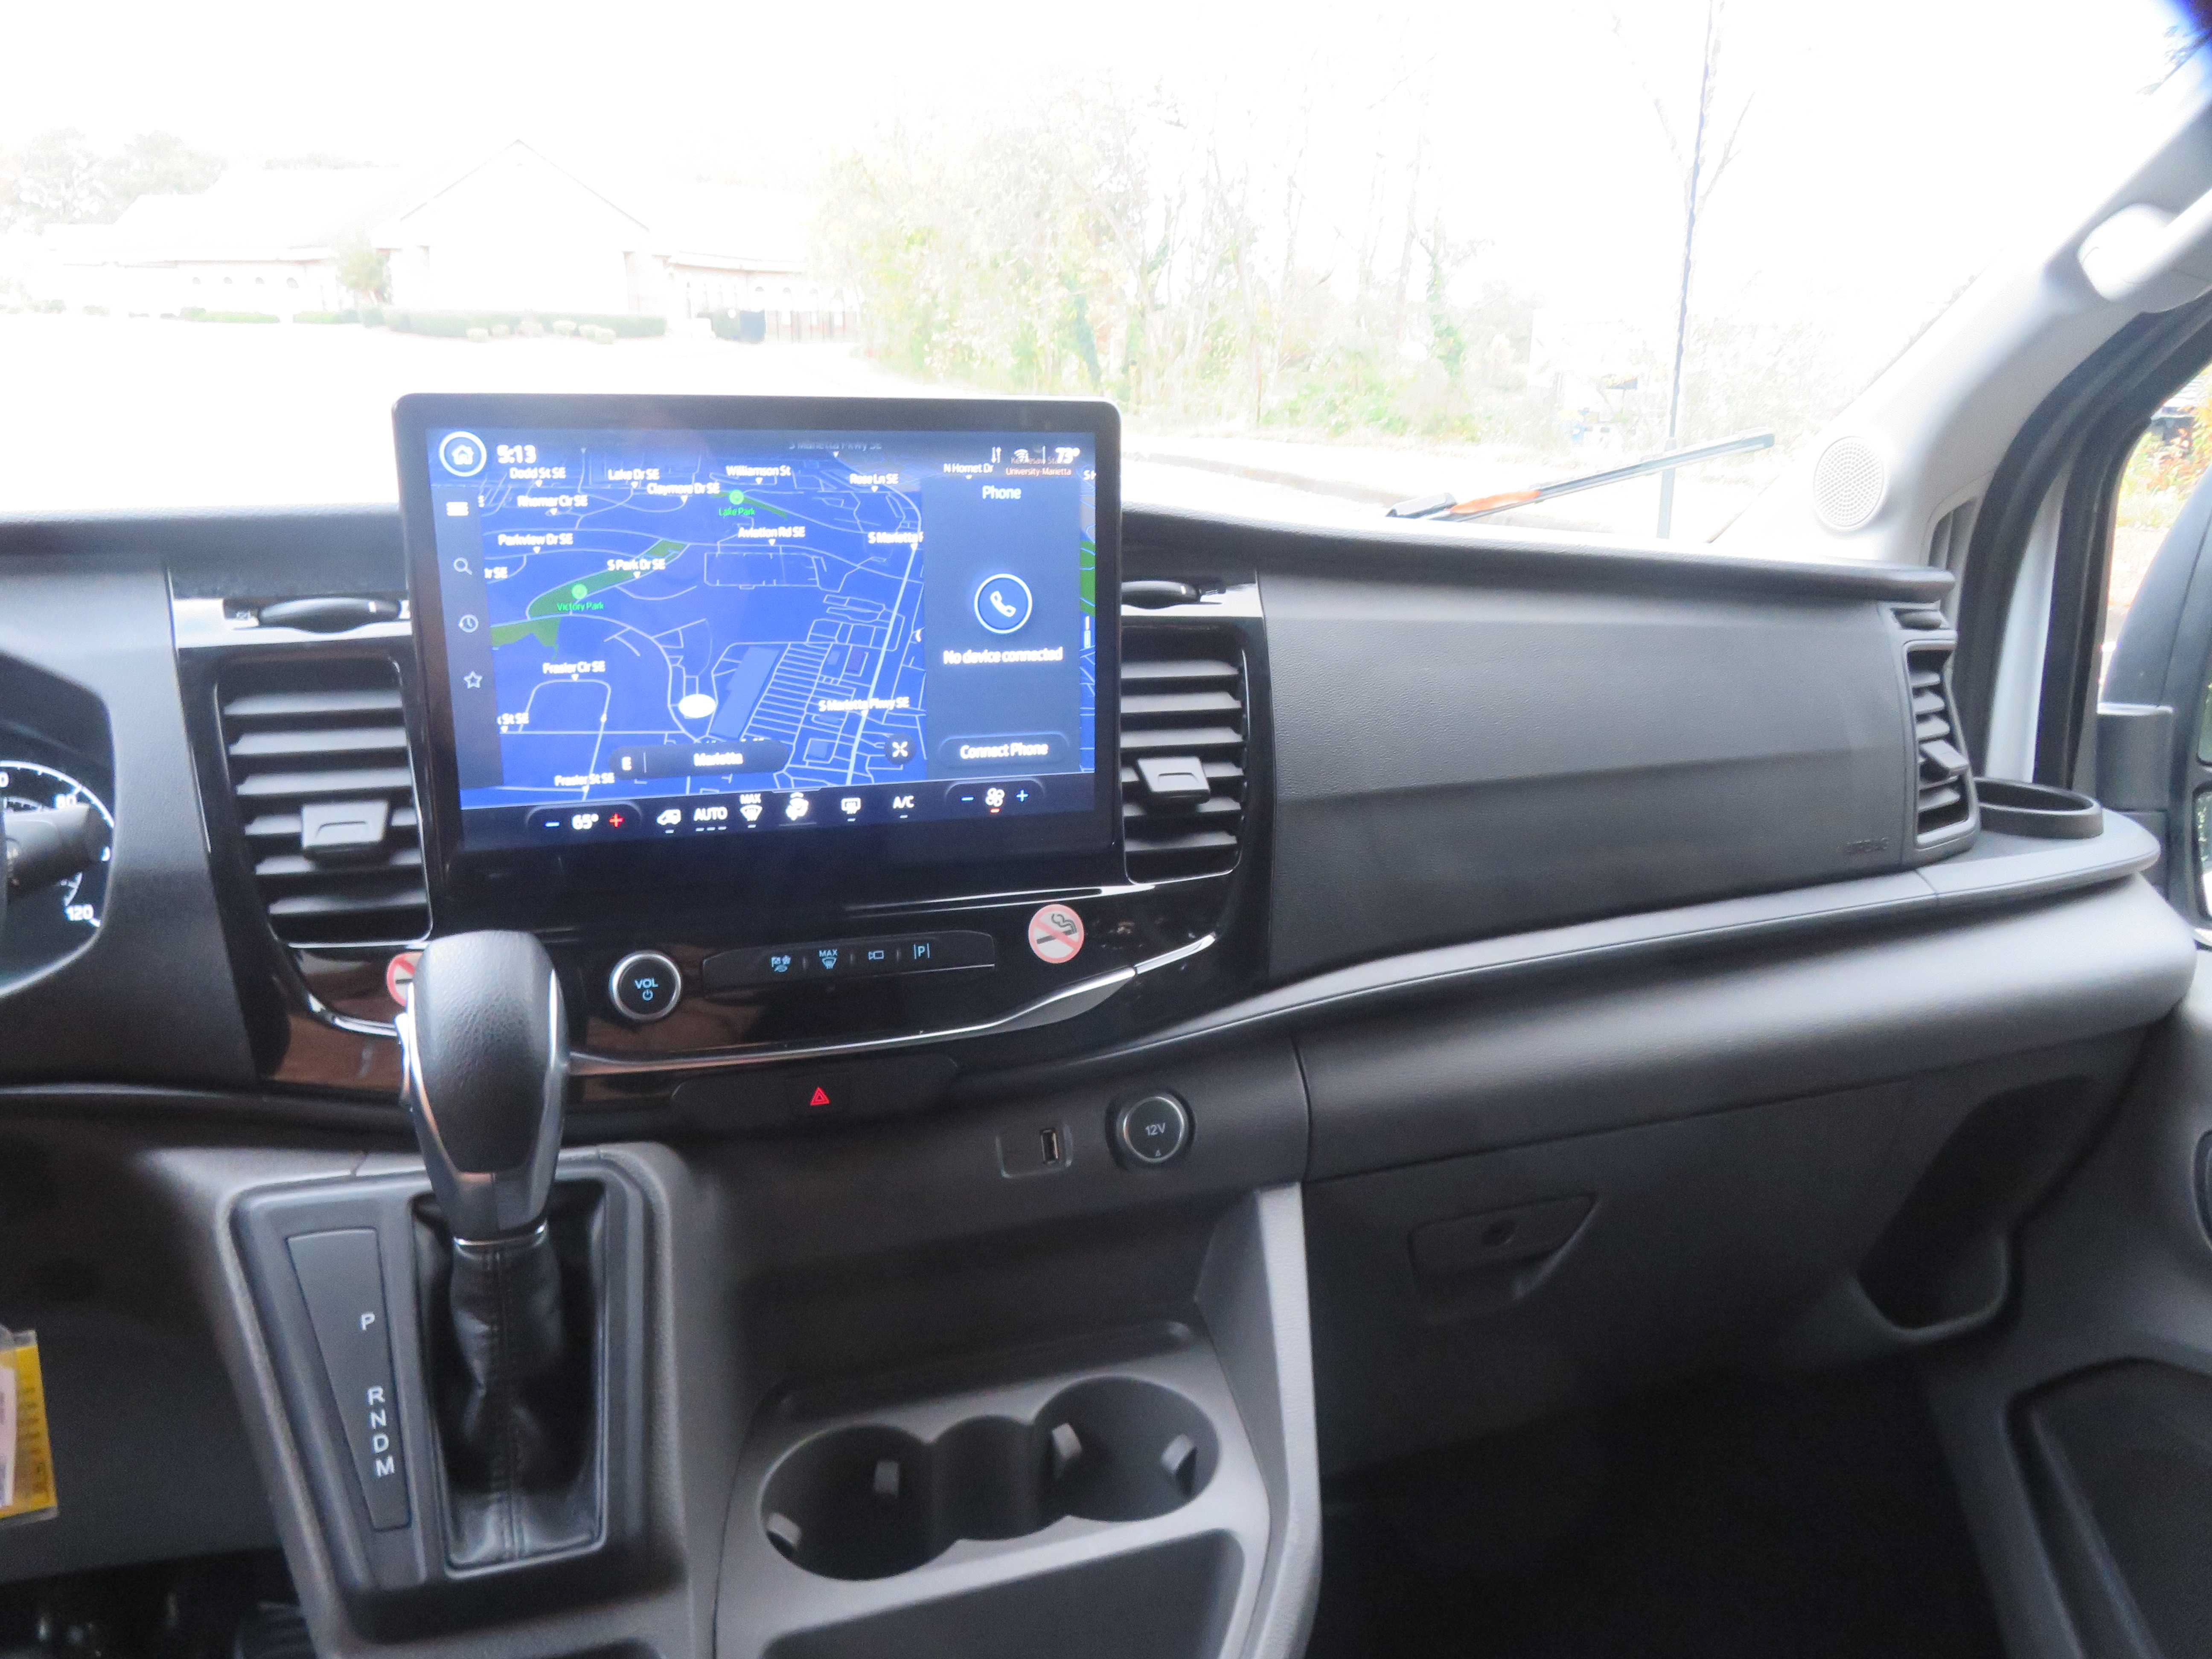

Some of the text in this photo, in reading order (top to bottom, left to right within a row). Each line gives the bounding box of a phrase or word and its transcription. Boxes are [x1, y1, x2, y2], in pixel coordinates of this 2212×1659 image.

[497, 445, 536, 463] 5:13
[552, 466, 566, 479] SE
[608, 469, 660, 480] Lake Dr SE
[726, 465, 791, 476] Williamson St
[943, 463, 951, 473] N
[983, 463, 994, 472] Dr
[1006, 467, 1072, 477] University-Marietta
[850, 473, 899, 484] Rose Ln SE
[693, 483, 706, 493] Dr
[706, 482, 720, 494] SE
[982, 485, 1021, 499] Phone
[573, 495, 588, 507] SE
[719, 507, 755, 516] Lake Park
[738, 526, 805, 538] Aviation Rd SE
[868, 531, 876, 544] S
[498, 533, 573, 546] Parkview Dr SE
[607, 558, 665, 571] S Park Dr SE
[556, 601, 604, 612] Victory Park
[943, 646, 1063, 664] No device connected
[592, 661, 605, 672] SE
[819, 700, 827, 712] S
[827, 699, 869, 710] Marietta
[896, 697, 909, 708] SE
[960, 742, 1048, 759] Connect Phone
[601, 772, 615, 784] SE
[740, 794, 761, 805] MAX
[893, 795, 914, 809] A/C
[694, 807, 728, 821] AUTO
[65, 903, 94, 921] 120
[819, 949, 838, 957] MAX
[634, 978, 658, 990] VOL
[1145, 1122, 1166, 1136] 12V
[361, 1311, 375, 1330] P
[367, 1385, 385, 1406] R
[370, 1409, 387, 1429] N
[372, 1433, 389, 1454] D
[375, 1455, 395, 1478] M
